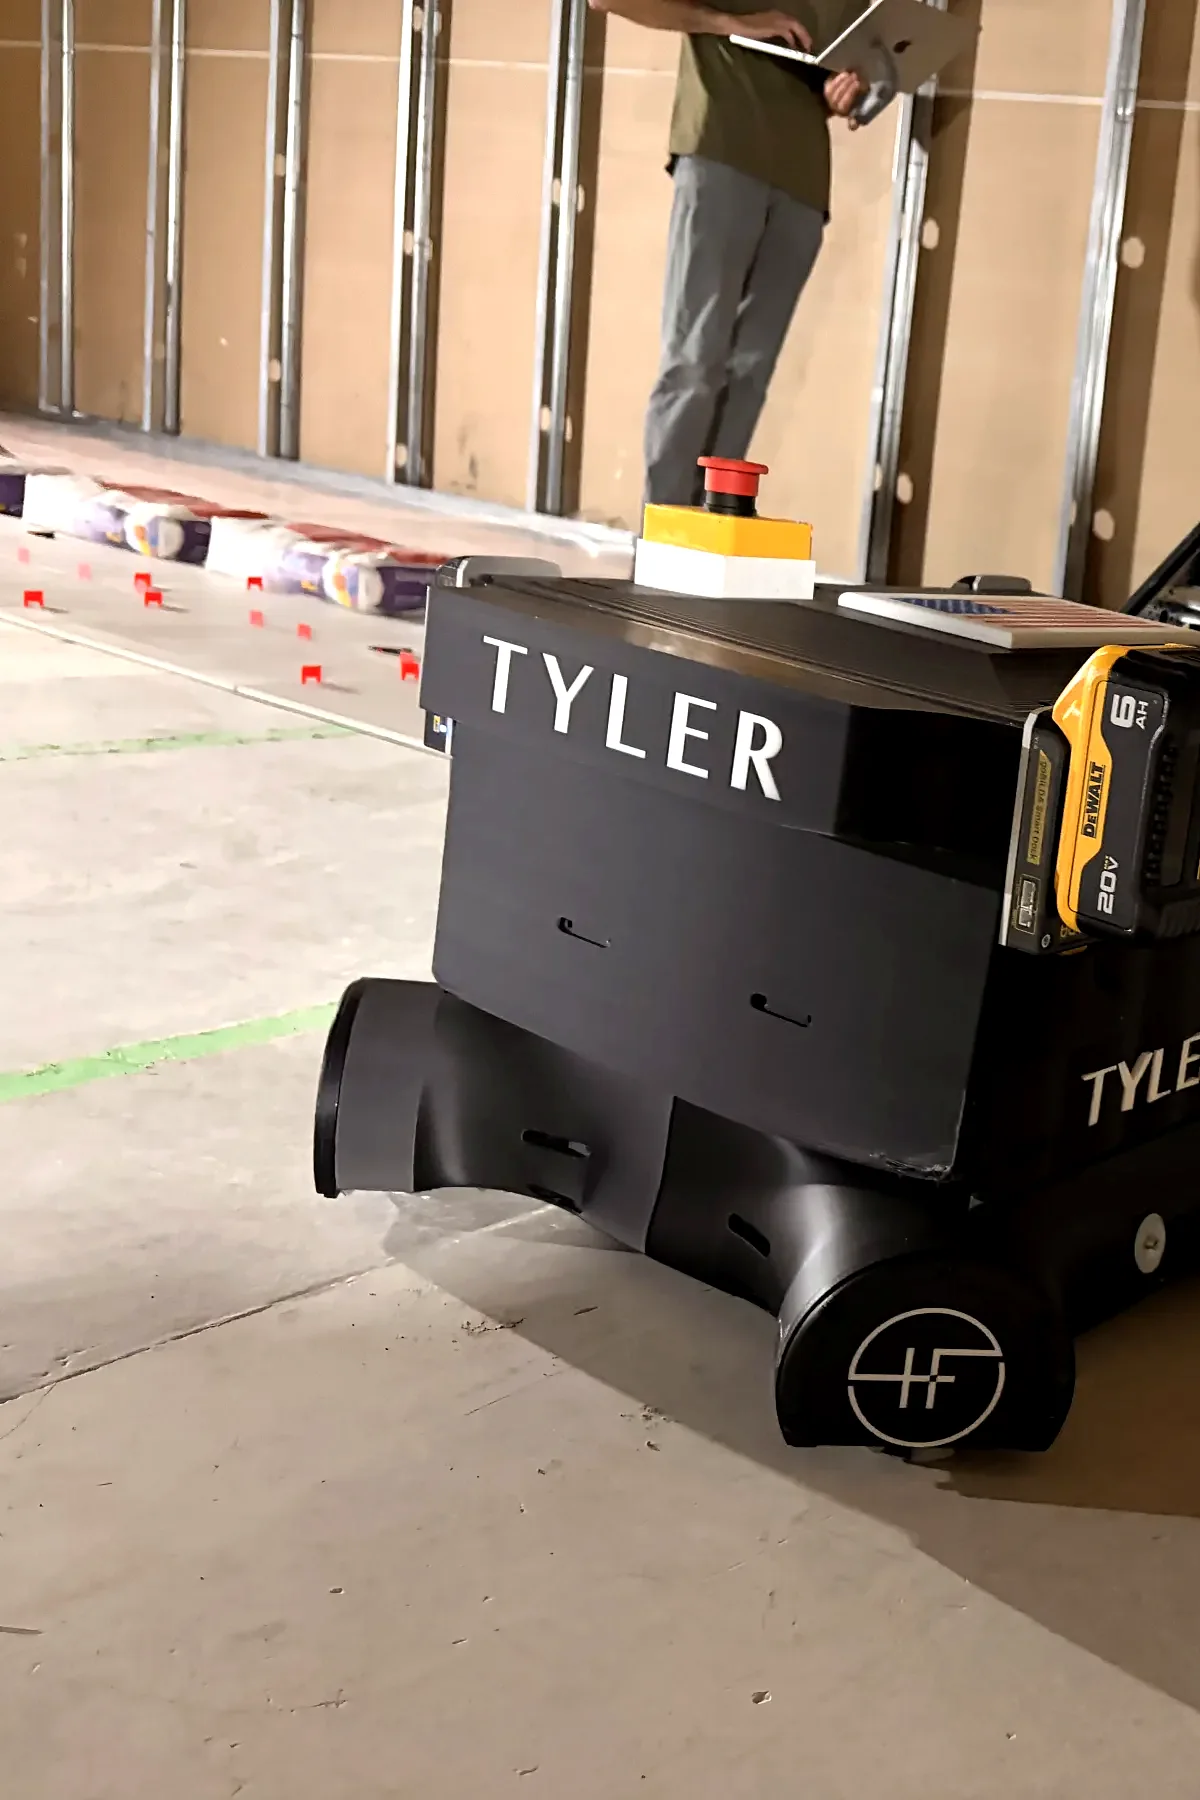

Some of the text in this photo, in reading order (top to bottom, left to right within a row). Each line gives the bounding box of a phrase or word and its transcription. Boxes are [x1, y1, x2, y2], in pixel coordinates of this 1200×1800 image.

[482, 635, 786, 802] TYLER
[1110, 693, 1149, 729] 6 AH
[1097, 856, 1119, 914] 20V
